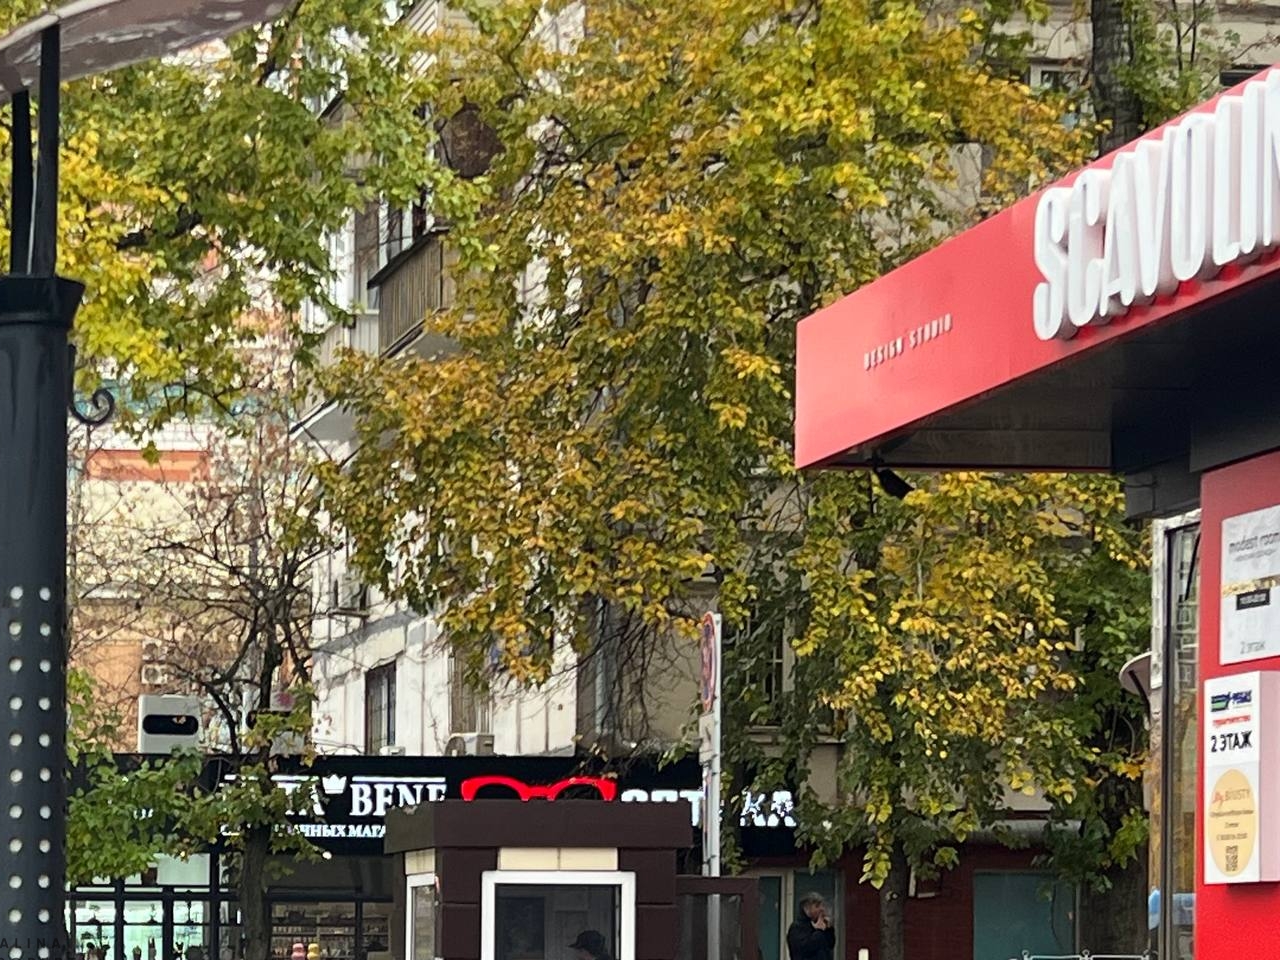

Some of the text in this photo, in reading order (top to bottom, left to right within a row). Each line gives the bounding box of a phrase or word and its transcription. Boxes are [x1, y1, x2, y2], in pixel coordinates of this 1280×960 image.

[863, 312, 953, 371] DESIGN STUDIO
[1210, 730, 1253, 752] 2 ЭТАЖ
